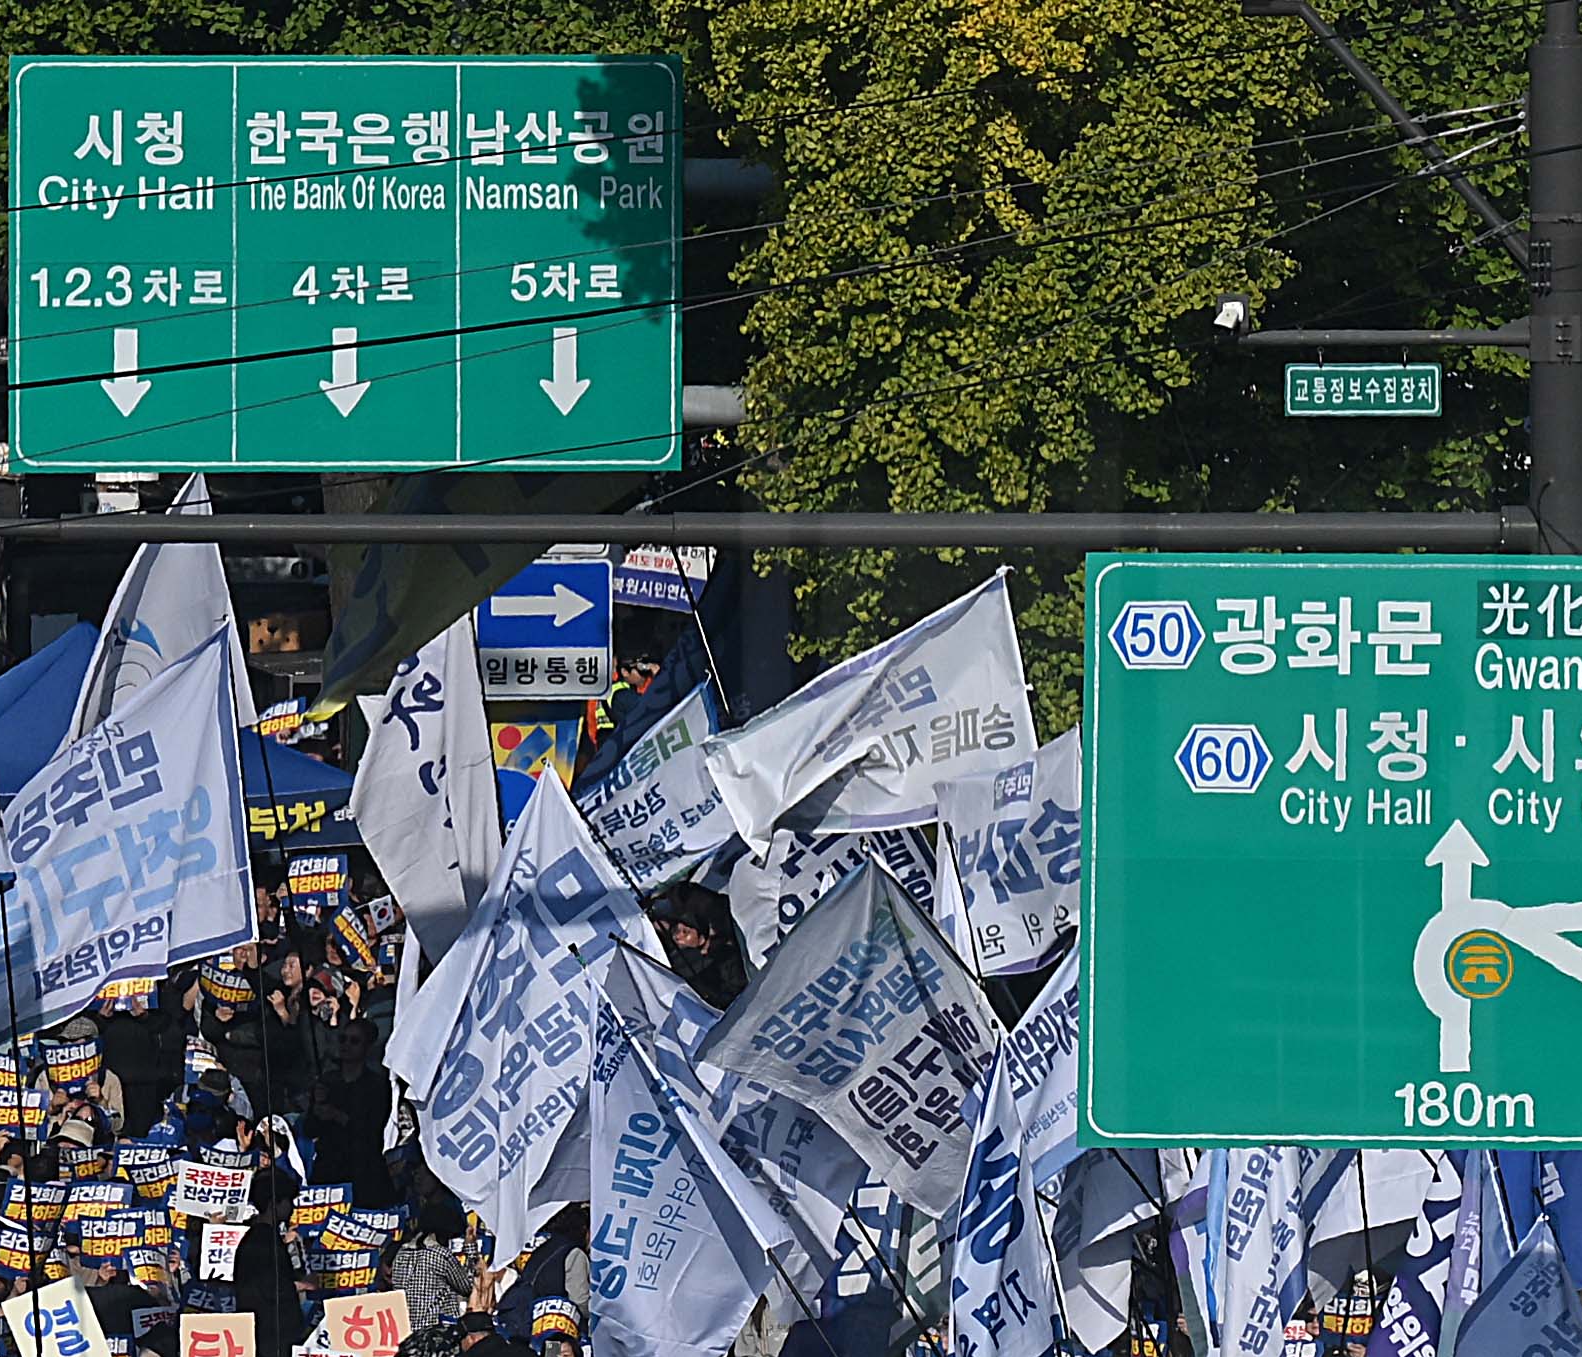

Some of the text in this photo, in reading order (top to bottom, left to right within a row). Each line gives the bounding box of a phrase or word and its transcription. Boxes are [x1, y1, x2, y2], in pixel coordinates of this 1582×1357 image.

[74, 110, 185, 166] 시청
[247, 110, 451, 166] 한국은행
[465, 110, 665, 166] 남산공원
[38, 176, 214, 219] City Hall
[248, 178, 445, 211] The Bank Of Korea
[465, 177, 663, 211] Namsan Park
[1295, 376, 1432, 404] 교통정보수집장치
[1127, 614, 1186, 659] 50
[1212, 596, 1442, 677] 광화문
[486, 655, 600, 686] 일방통행
[1193, 736, 1250, 783] 60
[1280, 789, 1431, 833] City Hall
[1488, 788, 1562, 833] City
[1396, 1081, 1535, 1129] 180m
[24, 1300, 90, 1357] 열
[342, 1304, 400, 1357] 핵
